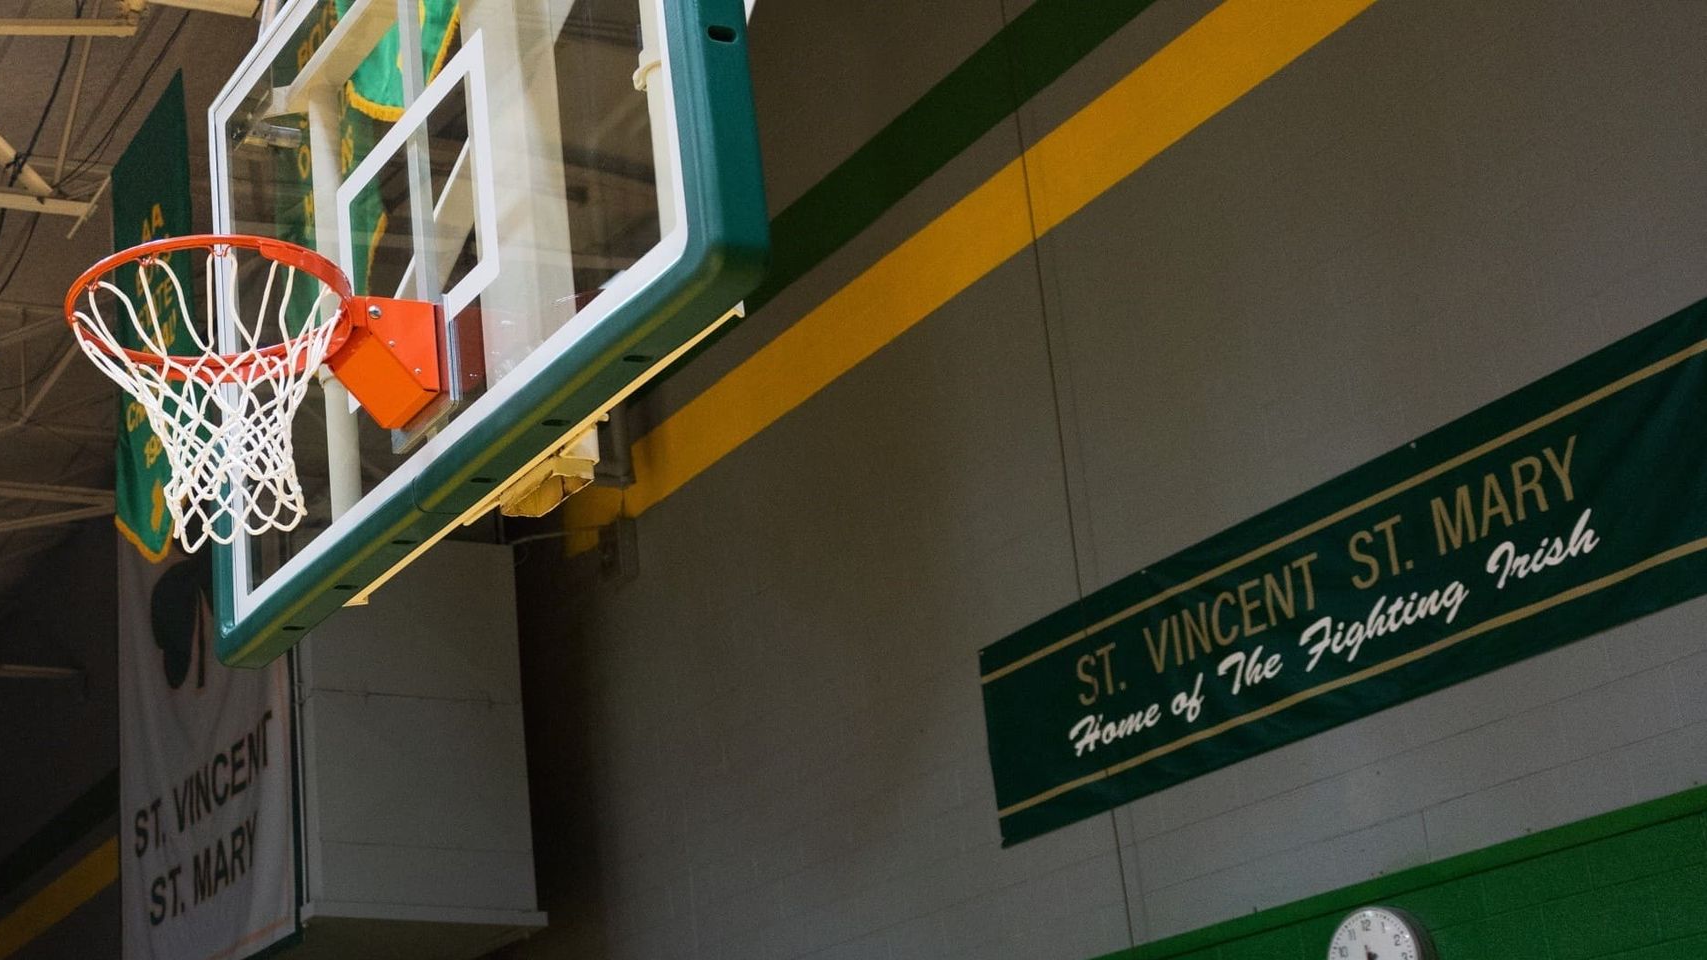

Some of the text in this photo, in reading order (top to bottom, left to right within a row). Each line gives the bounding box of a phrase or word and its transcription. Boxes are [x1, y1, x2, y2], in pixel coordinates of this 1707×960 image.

[1068, 507, 1601, 757] Home of The Fighting Irish
[1076, 434, 1579, 706] ST. VINCENT ST. MARY
[133, 709, 273, 859] ST. VINCENT
[149, 810, 259, 927] ST. MARY
